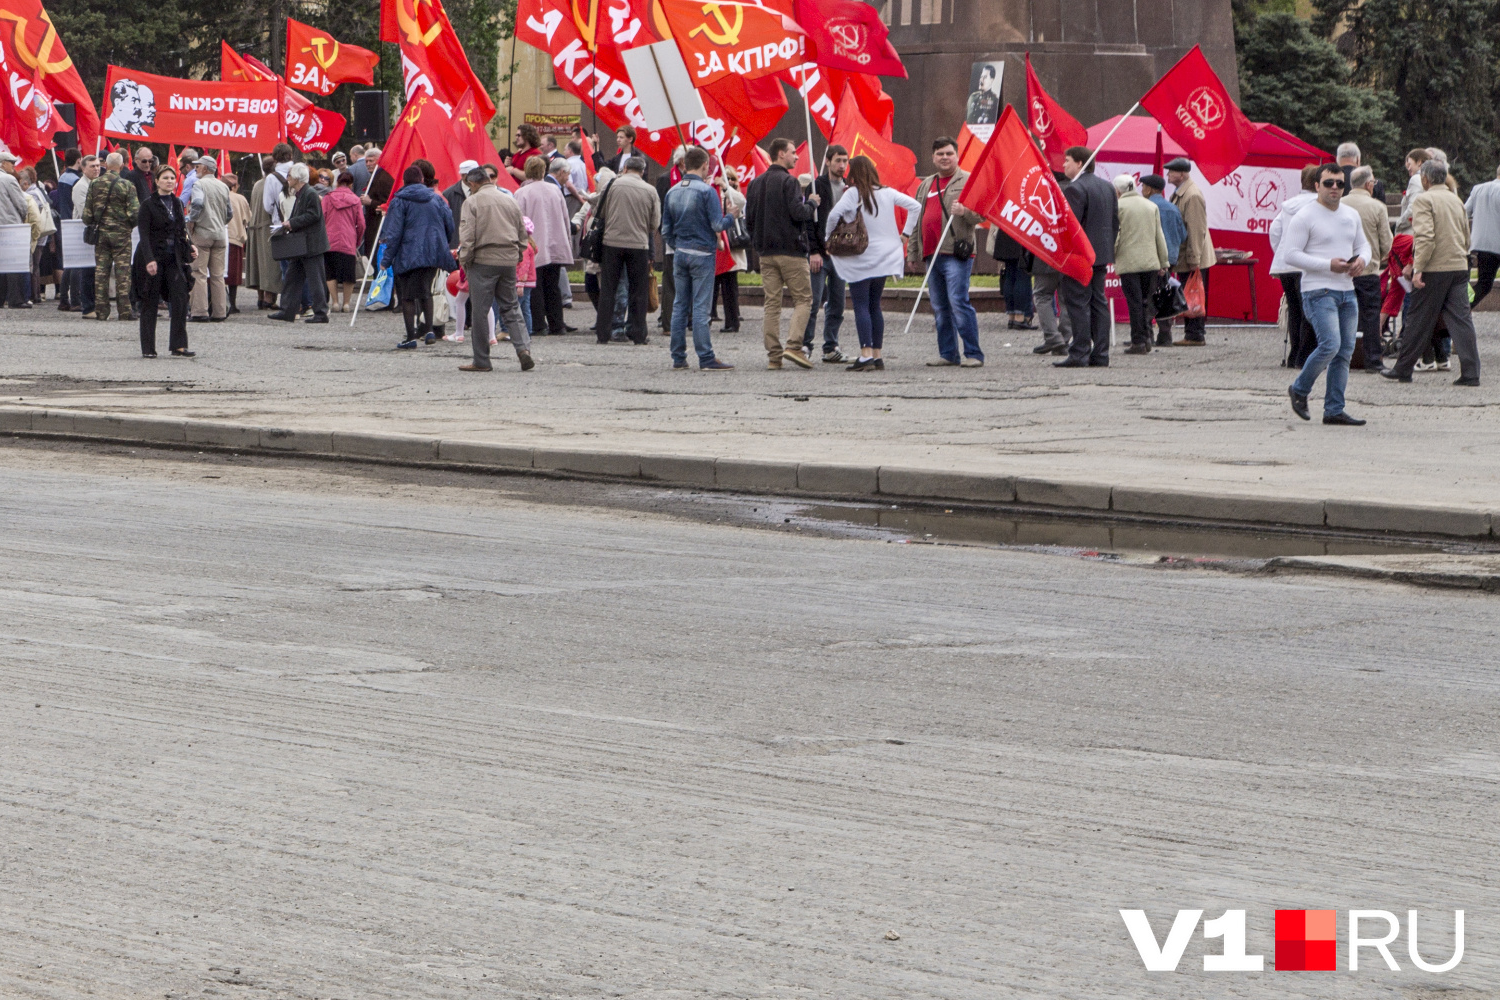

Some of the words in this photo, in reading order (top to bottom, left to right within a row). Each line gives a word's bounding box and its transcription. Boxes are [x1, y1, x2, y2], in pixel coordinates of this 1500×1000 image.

[290, 63, 319, 88] ЗА
[694, 50, 724, 79] ЗА
[728, 34, 806, 75] КПРФ!
[553, 38, 661, 142] КПРФ
[1174, 104, 1206, 141] КПРФ
[999, 199, 1058, 253] КПРФ
